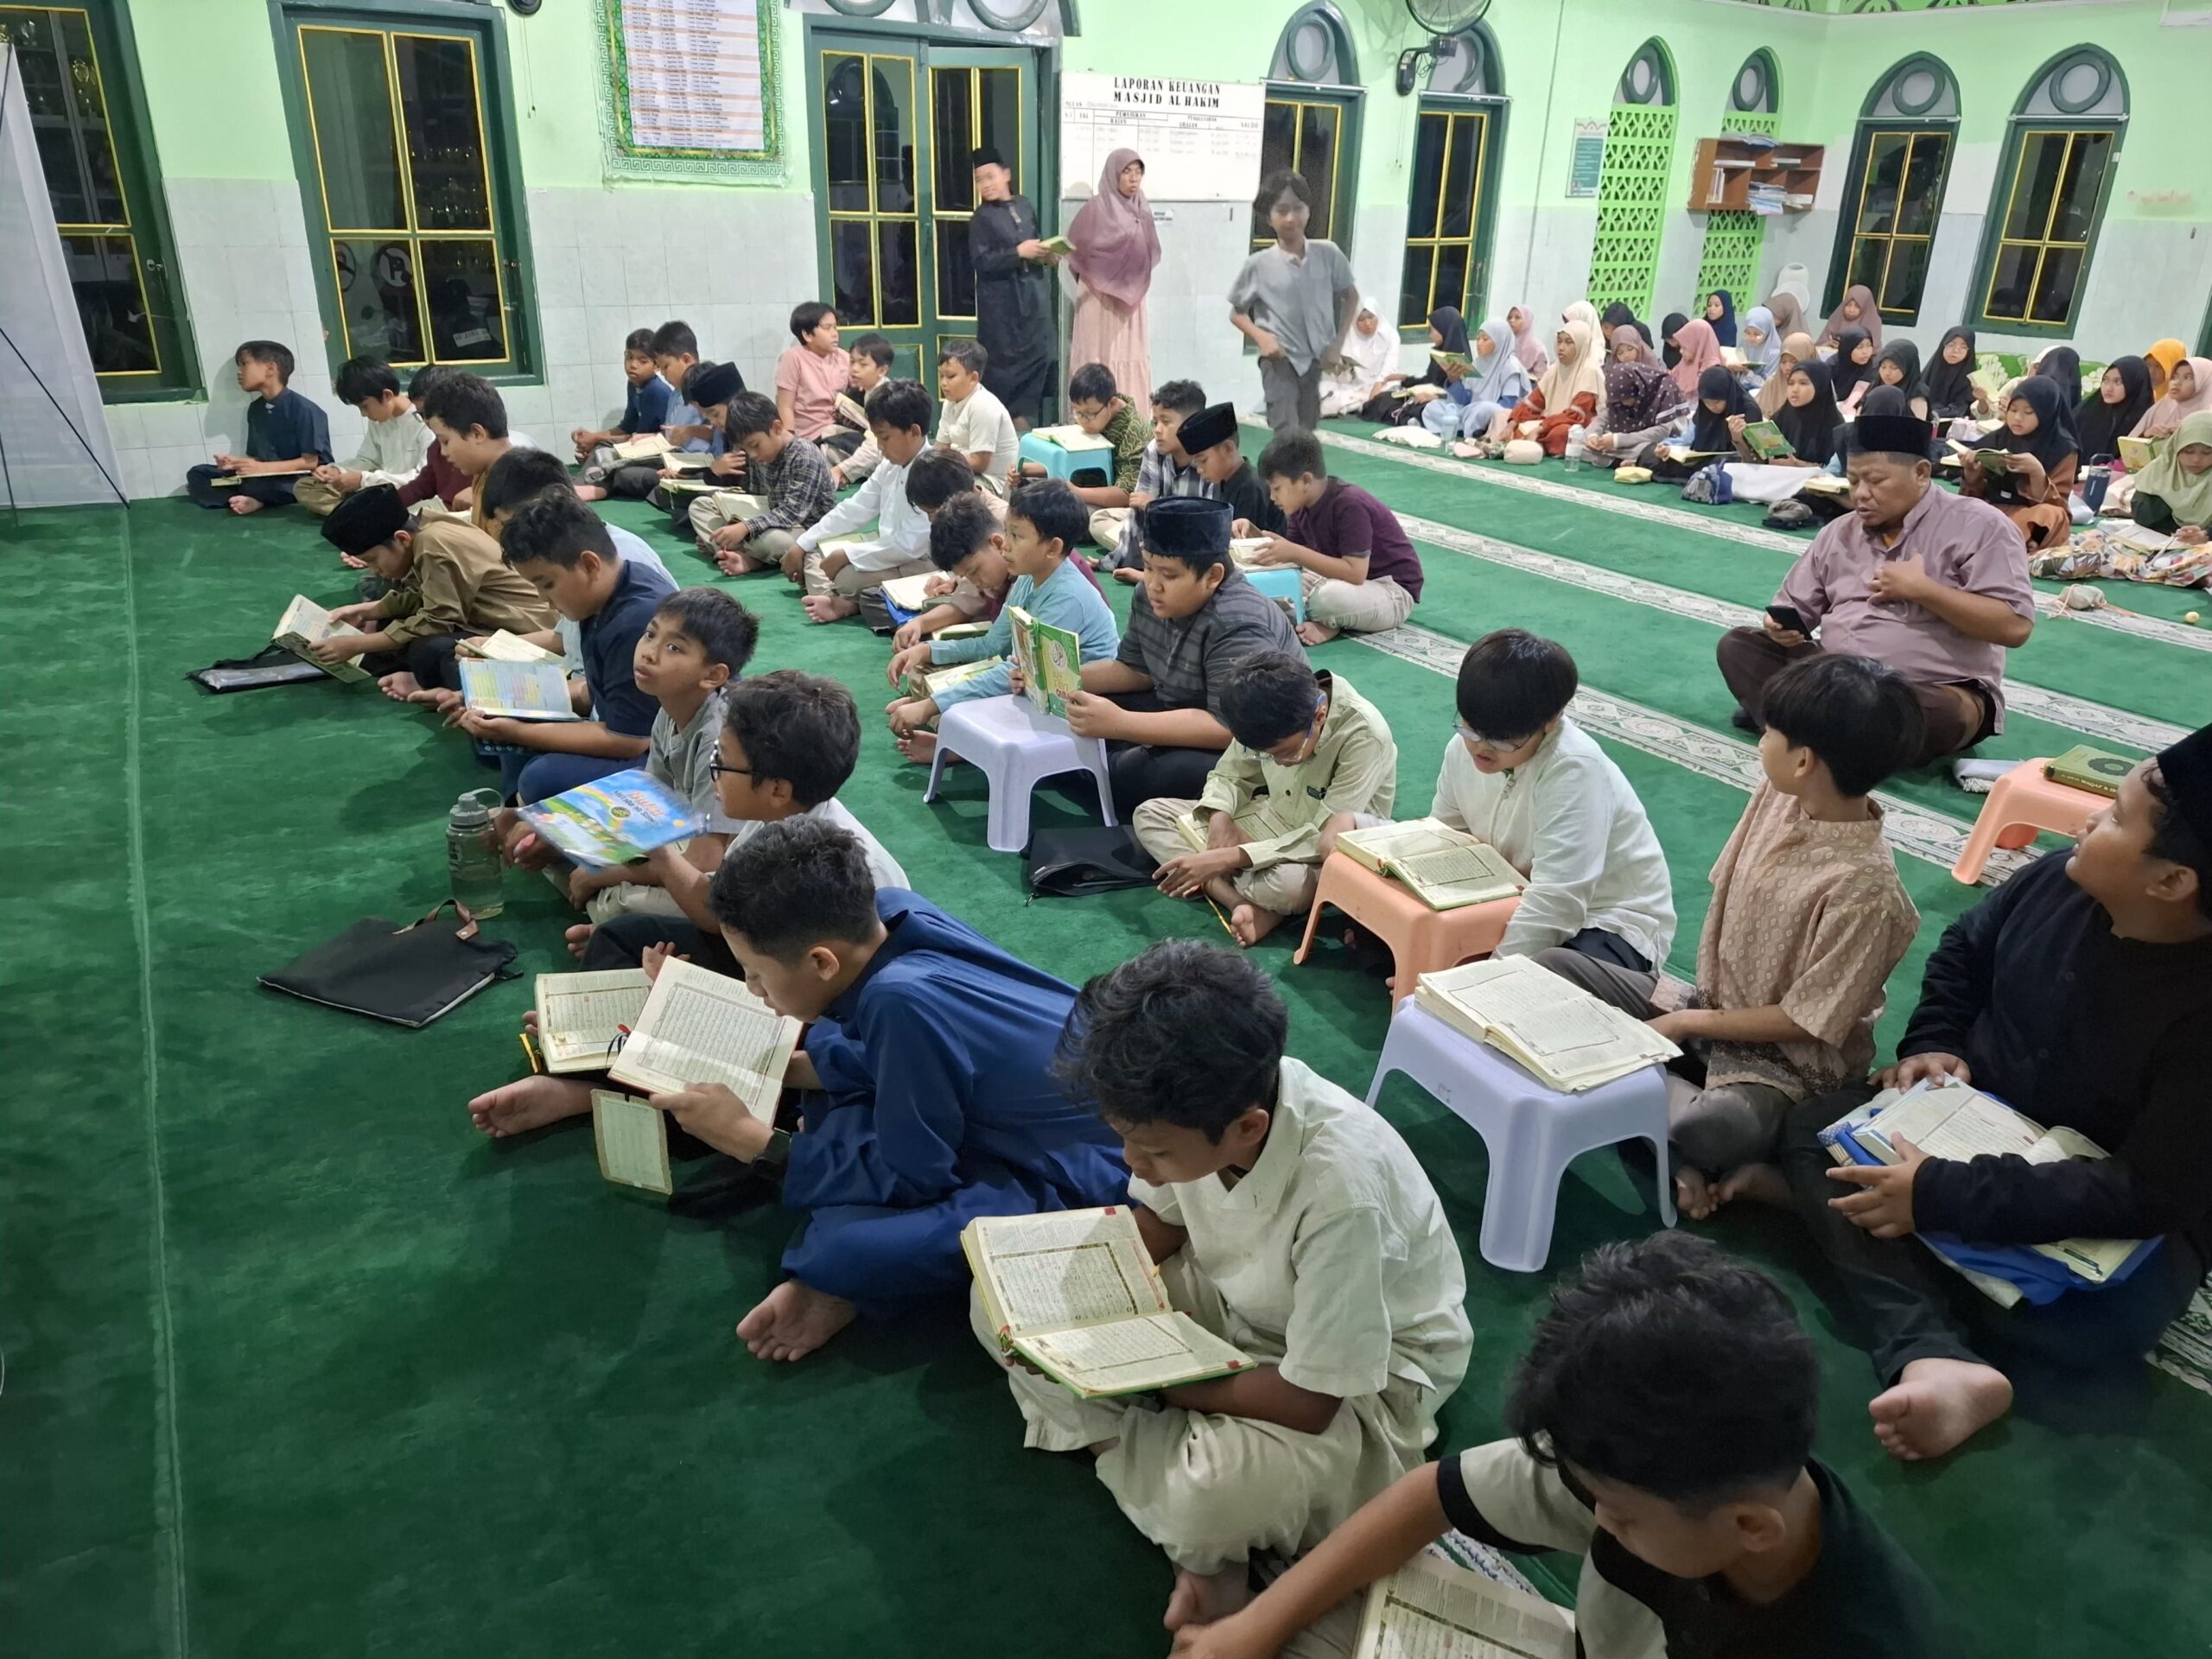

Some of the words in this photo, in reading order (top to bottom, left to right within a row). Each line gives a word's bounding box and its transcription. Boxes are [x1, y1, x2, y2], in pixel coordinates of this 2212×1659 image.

[1114, 77, 1163, 91] LAPORAN
[1169, 80, 1220, 95] KEUANGAN
[1114, 91, 1162, 105] MASJID
[1168, 94, 1181, 105] AL
[1185, 96, 1219, 108] HAKIM
